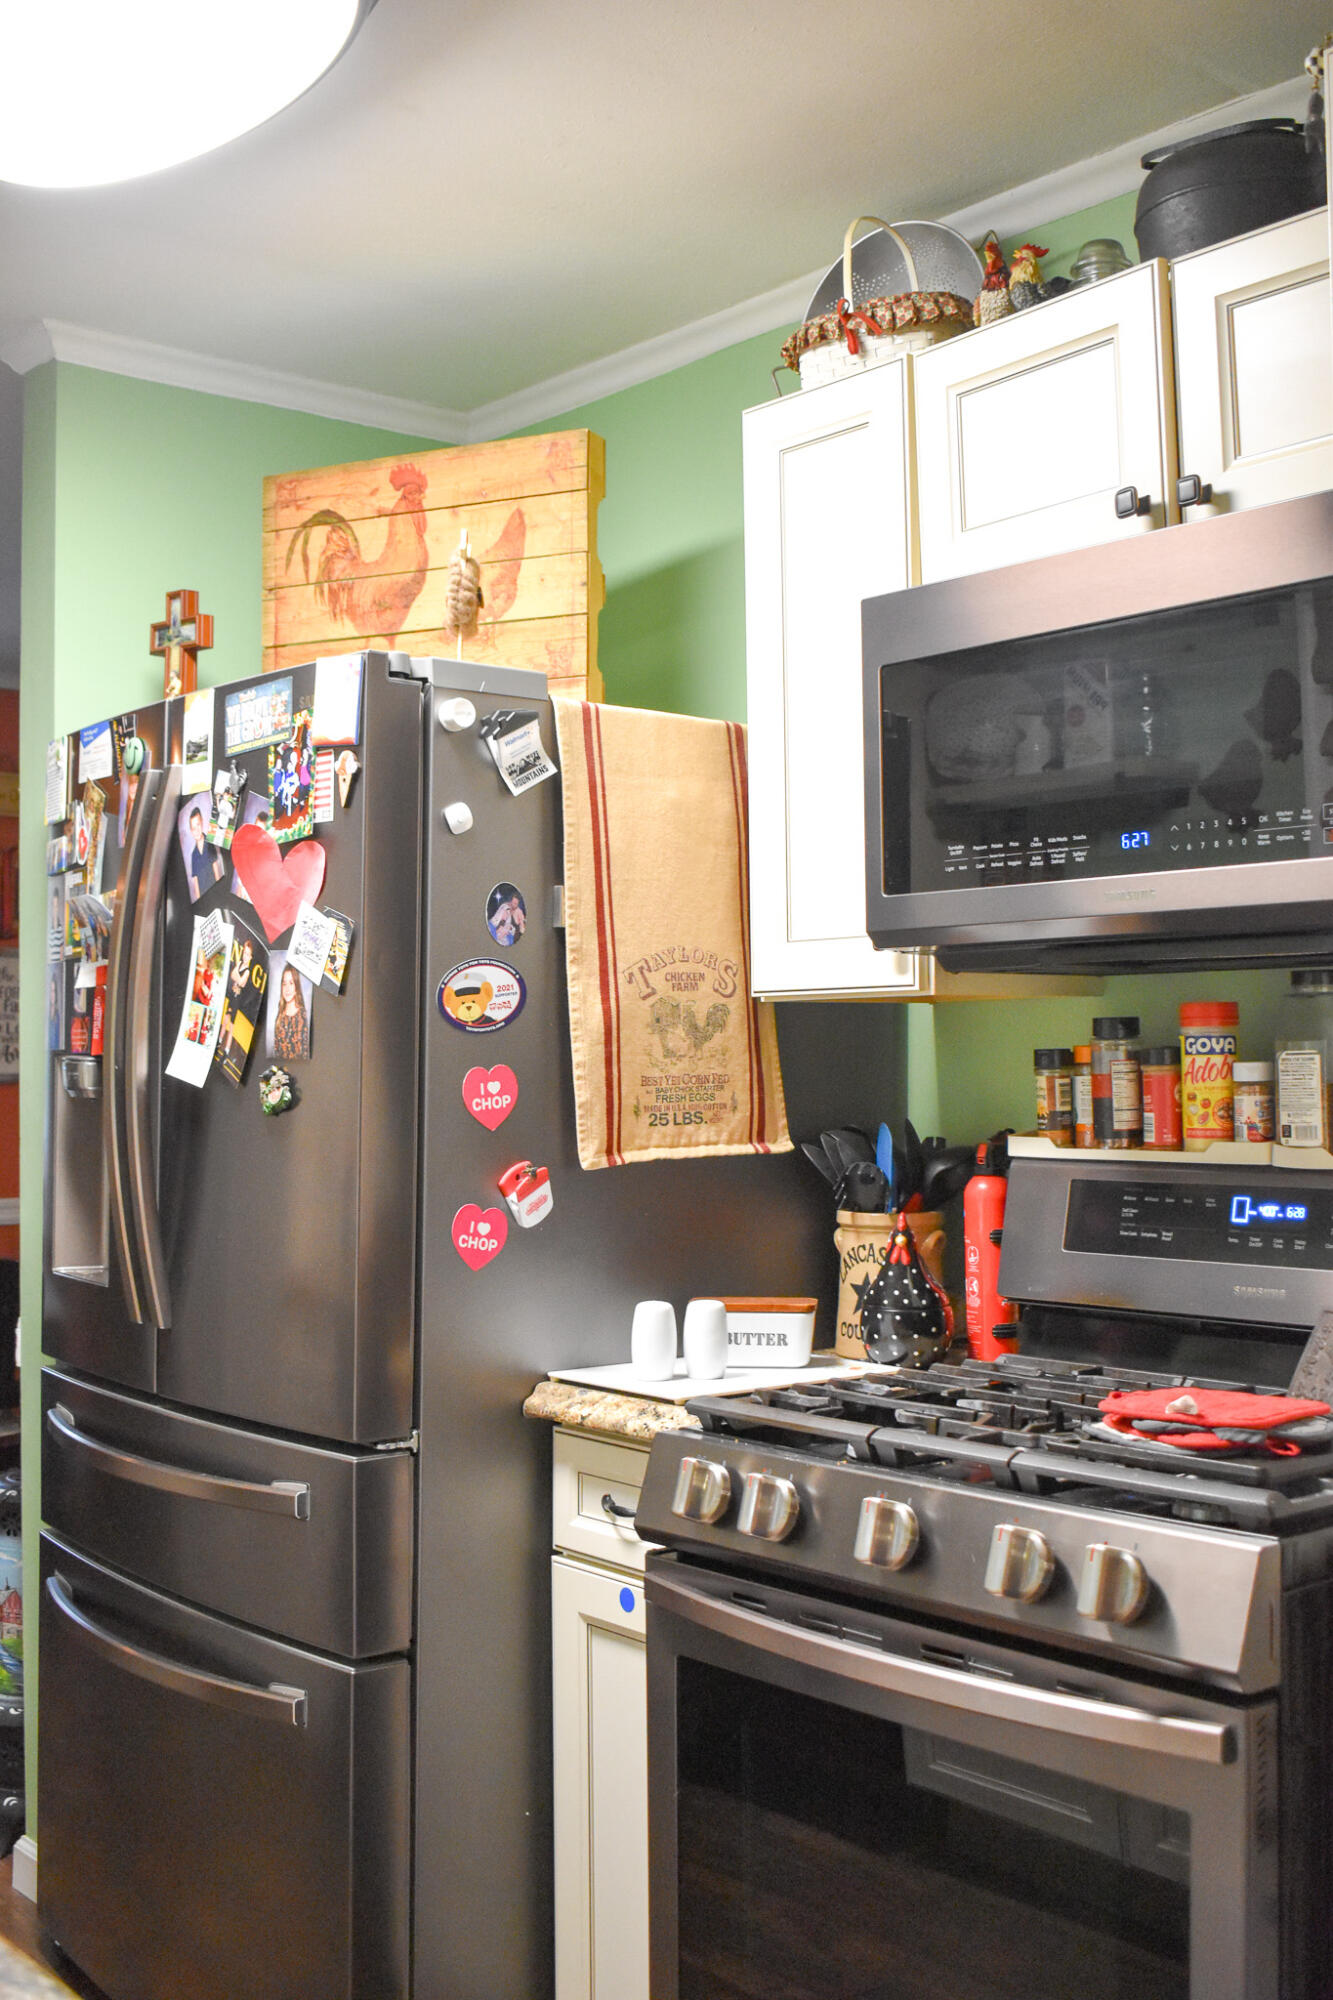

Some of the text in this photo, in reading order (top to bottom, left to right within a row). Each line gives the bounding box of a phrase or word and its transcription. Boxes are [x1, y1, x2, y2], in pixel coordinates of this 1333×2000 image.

[1214, 820, 1219, 828] 3
[1227, 818, 1233, 826] 4
[1241, 817, 1247, 825] 5
[1201, 842, 1205, 850] 7
[1214, 840, 1219, 848] 8
[1228, 839, 1233, 847] 9
[665, 972, 705, 982] CHICKEN
[496, 984, 514, 993] 2021
[672, 982, 698, 992] FARM
[1186, 1037, 1235, 1054] GOYA
[472, 1095, 512, 1112] CHOP
[655, 1093, 716, 1104] FRESH EGGS
[648, 1112, 670, 1127] 25
[673, 1111, 708, 1126] LBS.
[458, 1235, 498, 1251] CHOP
[840, 1243, 887, 1283] LANCAS
[841, 1322, 863, 1340] COU
[728, 1332, 788, 1346] BUTTER
